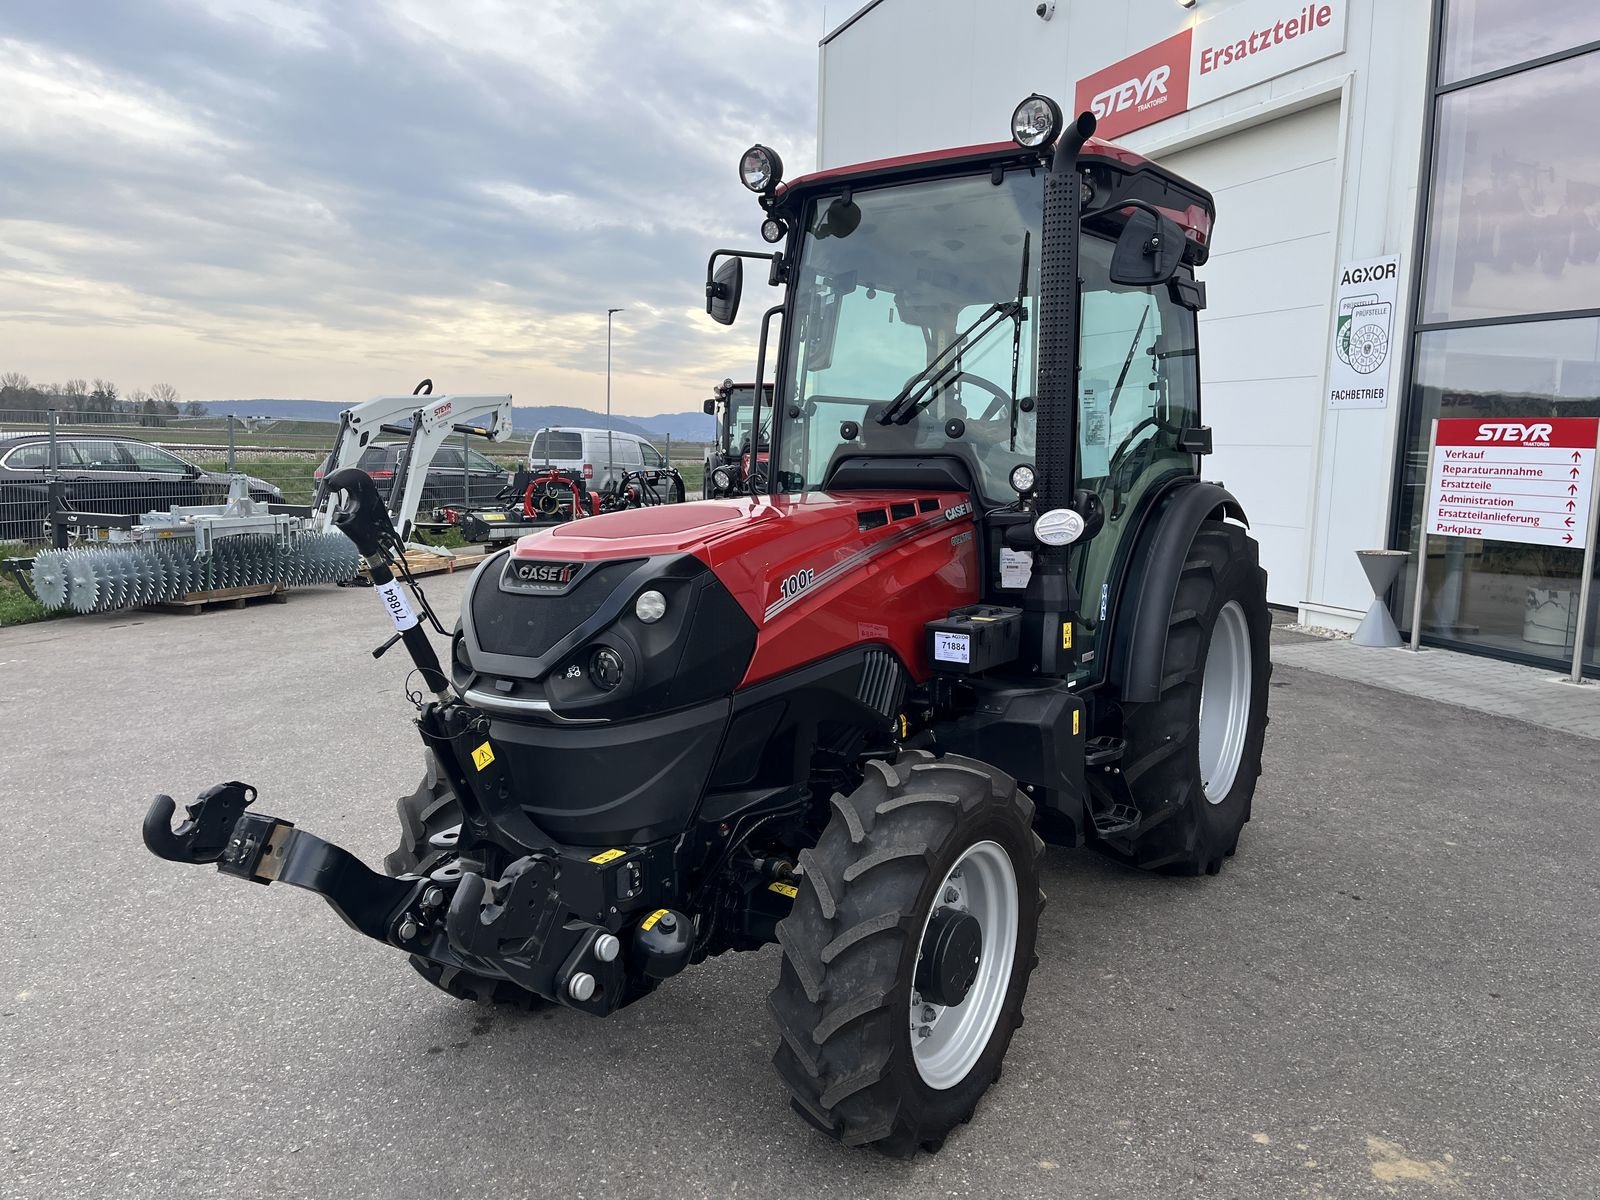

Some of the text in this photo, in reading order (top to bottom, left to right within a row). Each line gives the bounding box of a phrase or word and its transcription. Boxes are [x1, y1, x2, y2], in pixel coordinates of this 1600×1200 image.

[1199, 4, 1332, 75] Ersatzteile
[1090, 64, 1171, 121] STEYR
[1136, 95, 1168, 113] TRAKTOREN
[1340, 263, 1396, 286] AGXOR
[1355, 307, 1388, 318] PRÜFSTELLE
[1330, 388, 1384, 401] FACHBETRIEB
[434, 402, 452, 417] STEYR
[1475, 423, 1553, 442] STEYR
[1445, 450, 1486, 459] Verkauf
[1442, 464, 1543, 477] Reparaturannahme
[1441, 479, 1492, 490] Ersatzteile
[1440, 494, 1514, 507] Administration
[945, 503, 967, 521] CASE
[1438, 508, 1541, 526] Ersatzteilanlieferung
[1436, 523, 1482, 535] Parkplatz
[519, 566, 558, 581] CASE
[780, 568, 814, 600] 100F
[384, 588, 407, 622] 71884
[941, 641, 966, 651] 71884
